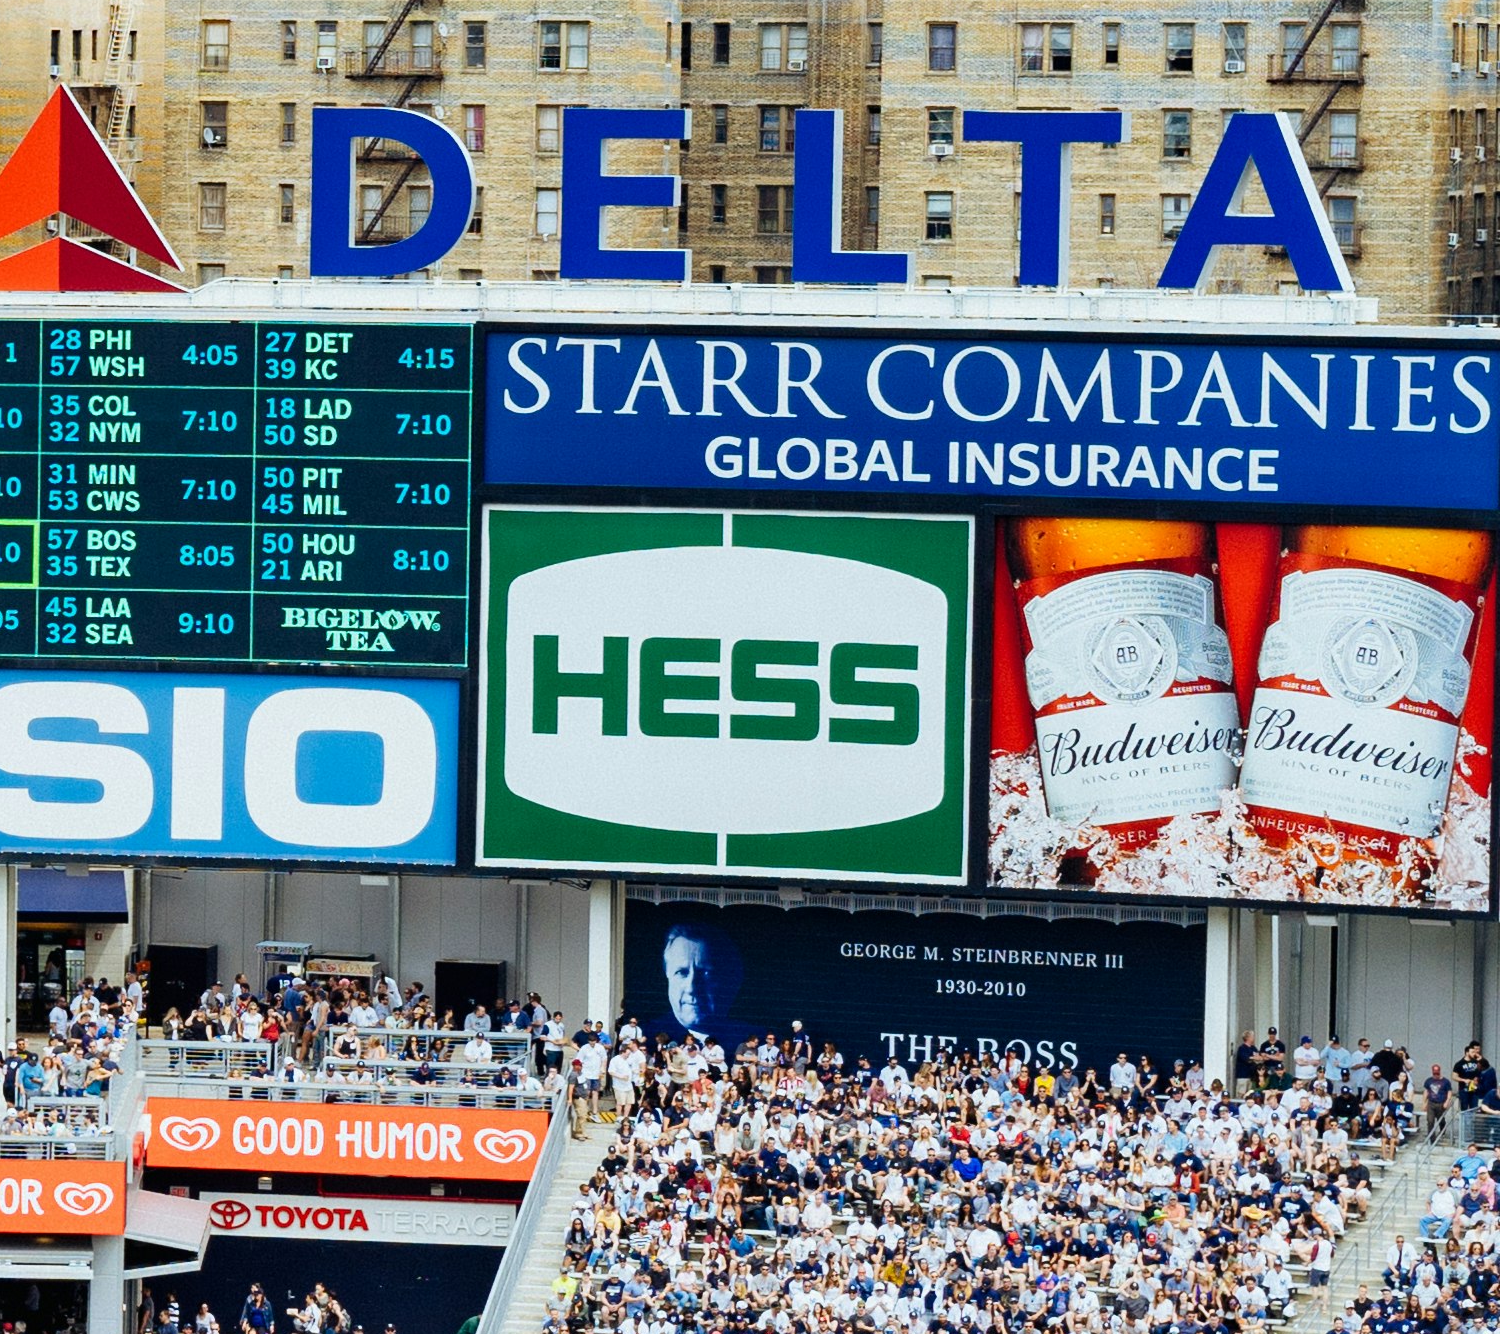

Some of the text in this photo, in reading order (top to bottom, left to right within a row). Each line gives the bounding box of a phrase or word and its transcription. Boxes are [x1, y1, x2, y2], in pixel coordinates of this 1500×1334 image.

[310, 107, 1354, 293] DELTA
[503, 336, 1493, 434] STARR COMPANIES
[704, 435, 1279, 492] GLOBAL INSURANCE
[281, 608, 439, 629] BIGELOW
[327, 632, 395, 651] TEA
[532, 635, 919, 746] HESS
[1041, 720, 1239, 777] Budweiser
[1254, 705, 1449, 781] Budweiser
[840, 942, 1125, 969] GEORGE M. STEINBRENNER III
[935, 978, 1026, 997] 1930-2010
[255, 1205, 508, 1238] TOYOTA TERRACE
